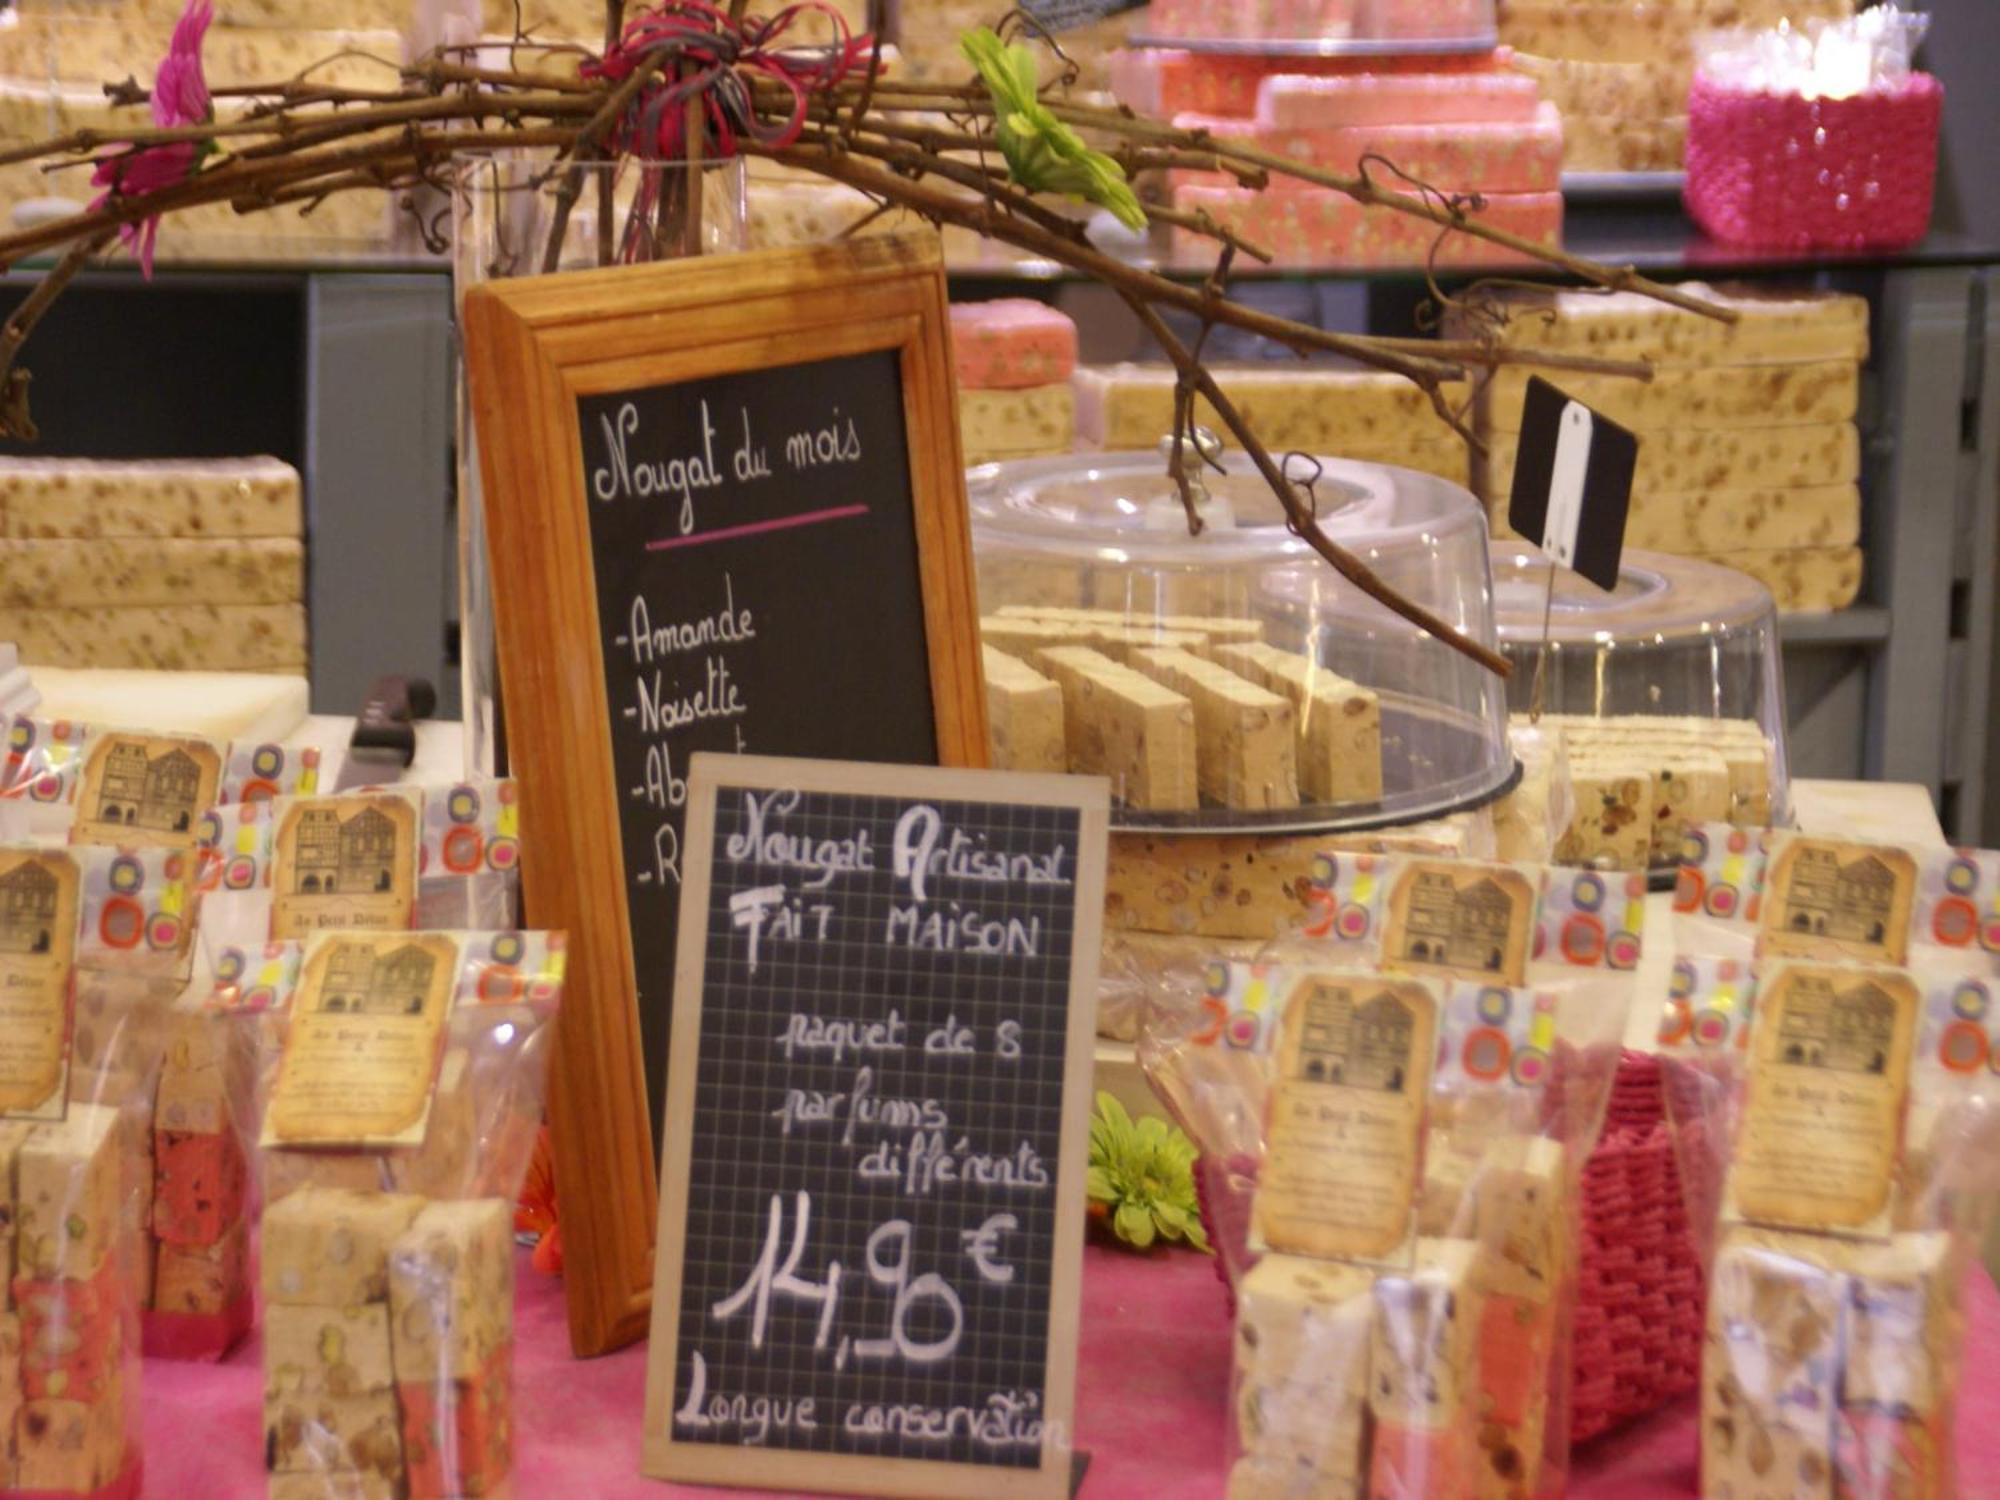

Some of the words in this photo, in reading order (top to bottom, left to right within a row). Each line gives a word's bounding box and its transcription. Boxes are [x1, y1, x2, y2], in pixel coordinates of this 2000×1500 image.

[595, 400, 722, 534] Nougat
[735, 407, 771, 478] du
[786, 407, 861, 464] mois
[726, 788, 876, 887] Nougat
[893, 805, 1071, 900] Artisanal
[775, 1008, 904, 1061] paquet
[924, 1014, 975, 1053] de
[772, 1065, 948, 1146] parfums
[858, 1130, 1049, 1194] différents
[675, 1350, 818, 1444] Longue
